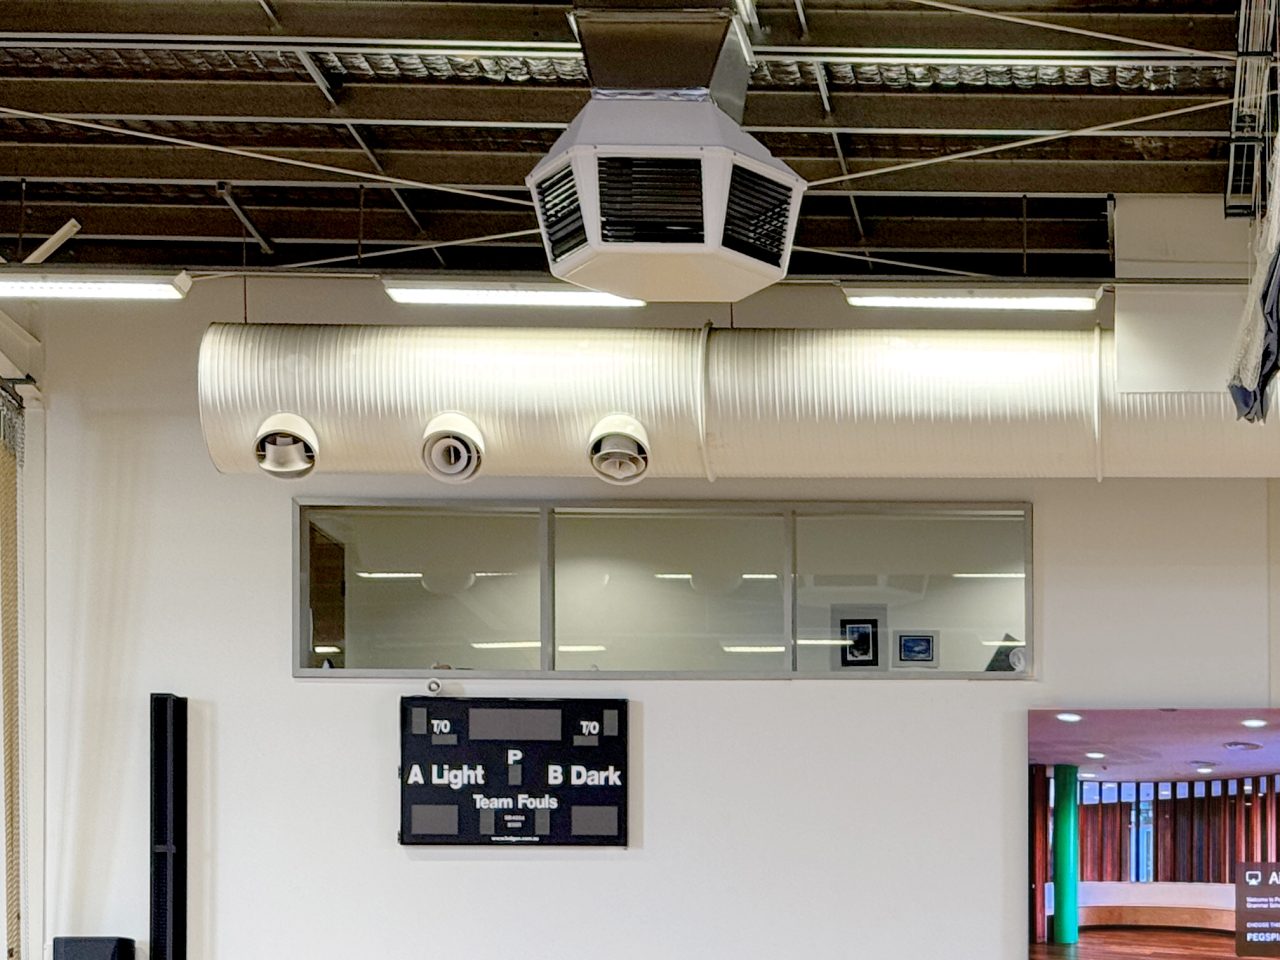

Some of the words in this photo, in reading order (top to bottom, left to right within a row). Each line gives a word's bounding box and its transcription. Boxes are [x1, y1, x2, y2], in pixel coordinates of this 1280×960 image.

[507, 749, 523, 765] P
[407, 764, 425, 785] A
[431, 764, 485, 790] Light
[547, 764, 564, 785] B
[570, 764, 622, 786] Dark
[472, 794, 513, 809] Team
[517, 794, 558, 810] Fouls
